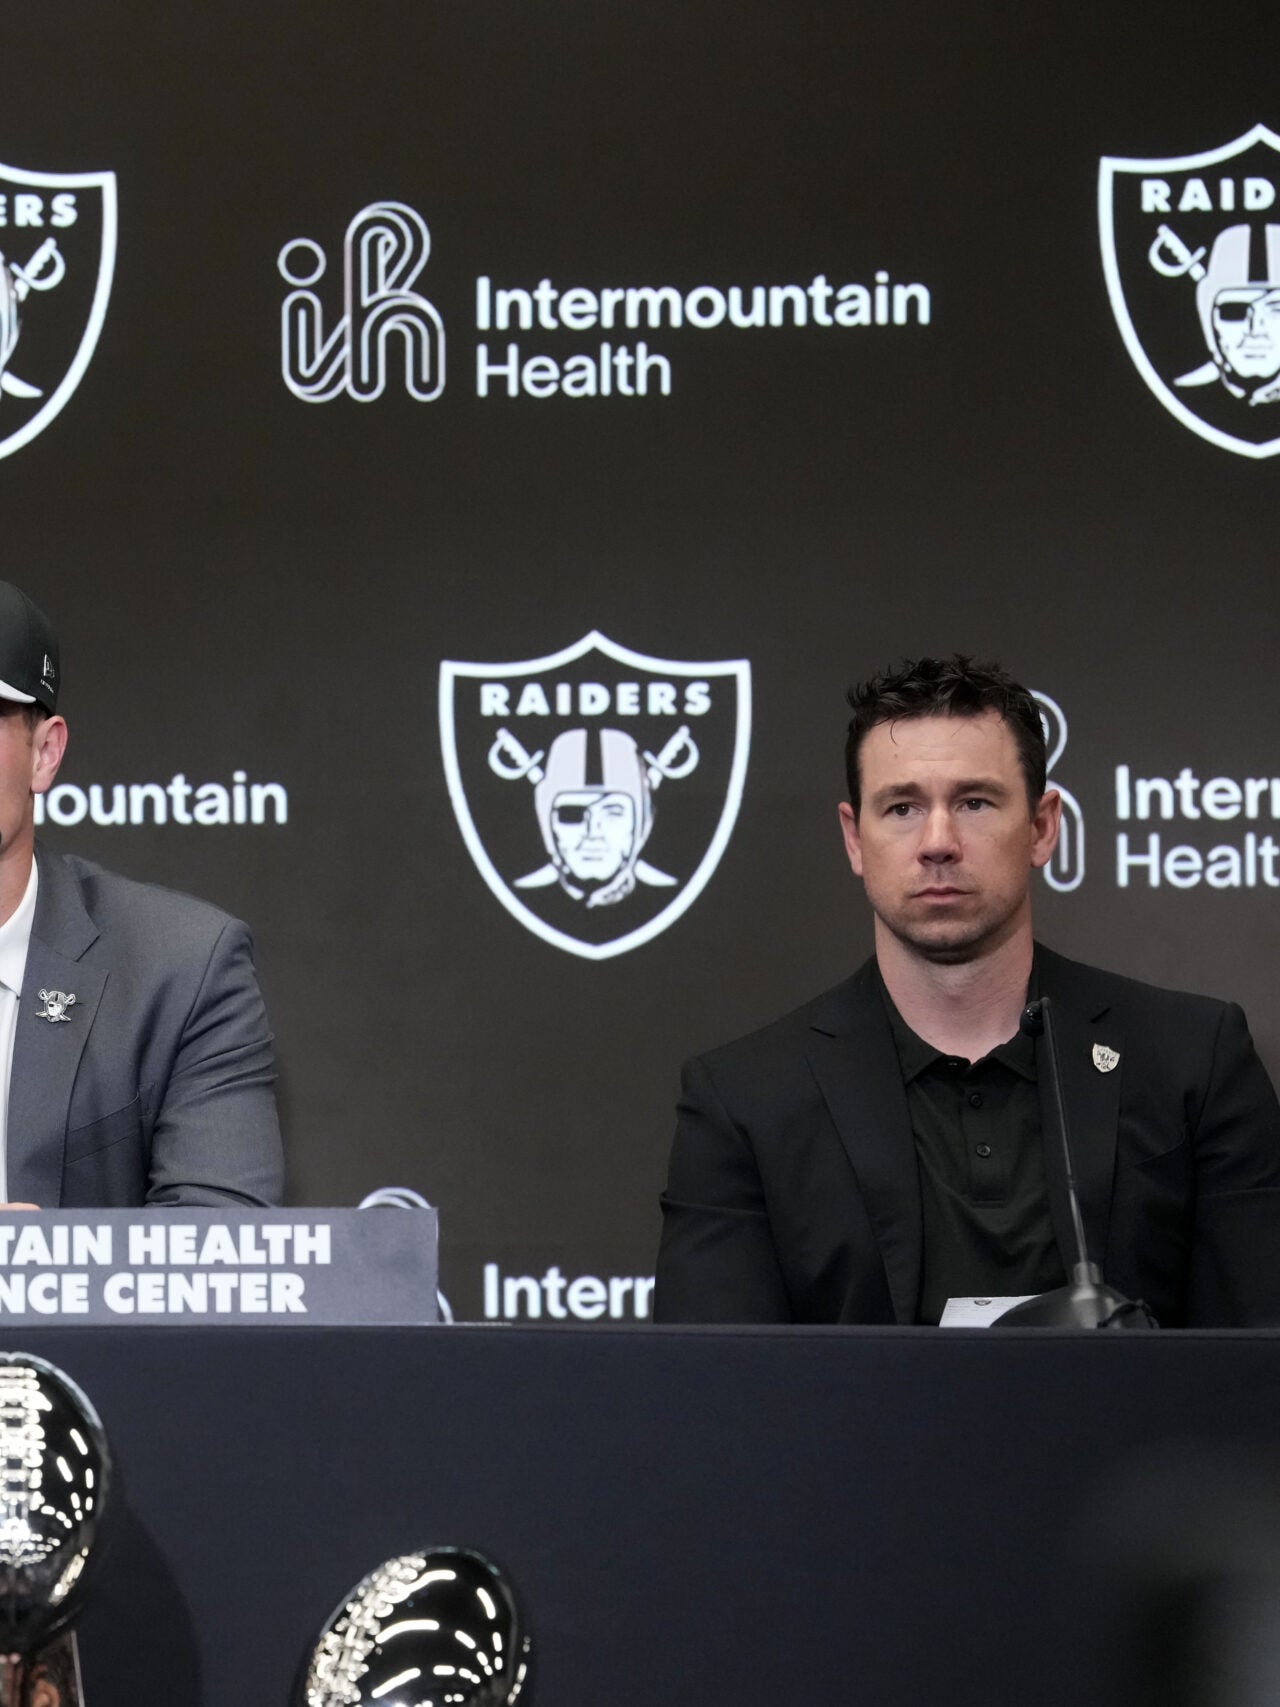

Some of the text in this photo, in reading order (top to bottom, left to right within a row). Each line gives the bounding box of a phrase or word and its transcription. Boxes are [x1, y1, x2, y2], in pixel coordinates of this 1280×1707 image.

[476, 271, 931, 330] Intermountain
[476, 342, 671, 398] Health
[480, 682, 712, 717] RAIDERS
[1115, 764, 1280, 820] Inter
[128, 1224, 332, 1265] HEALTH
[103, 1272, 307, 1315] CENTER
